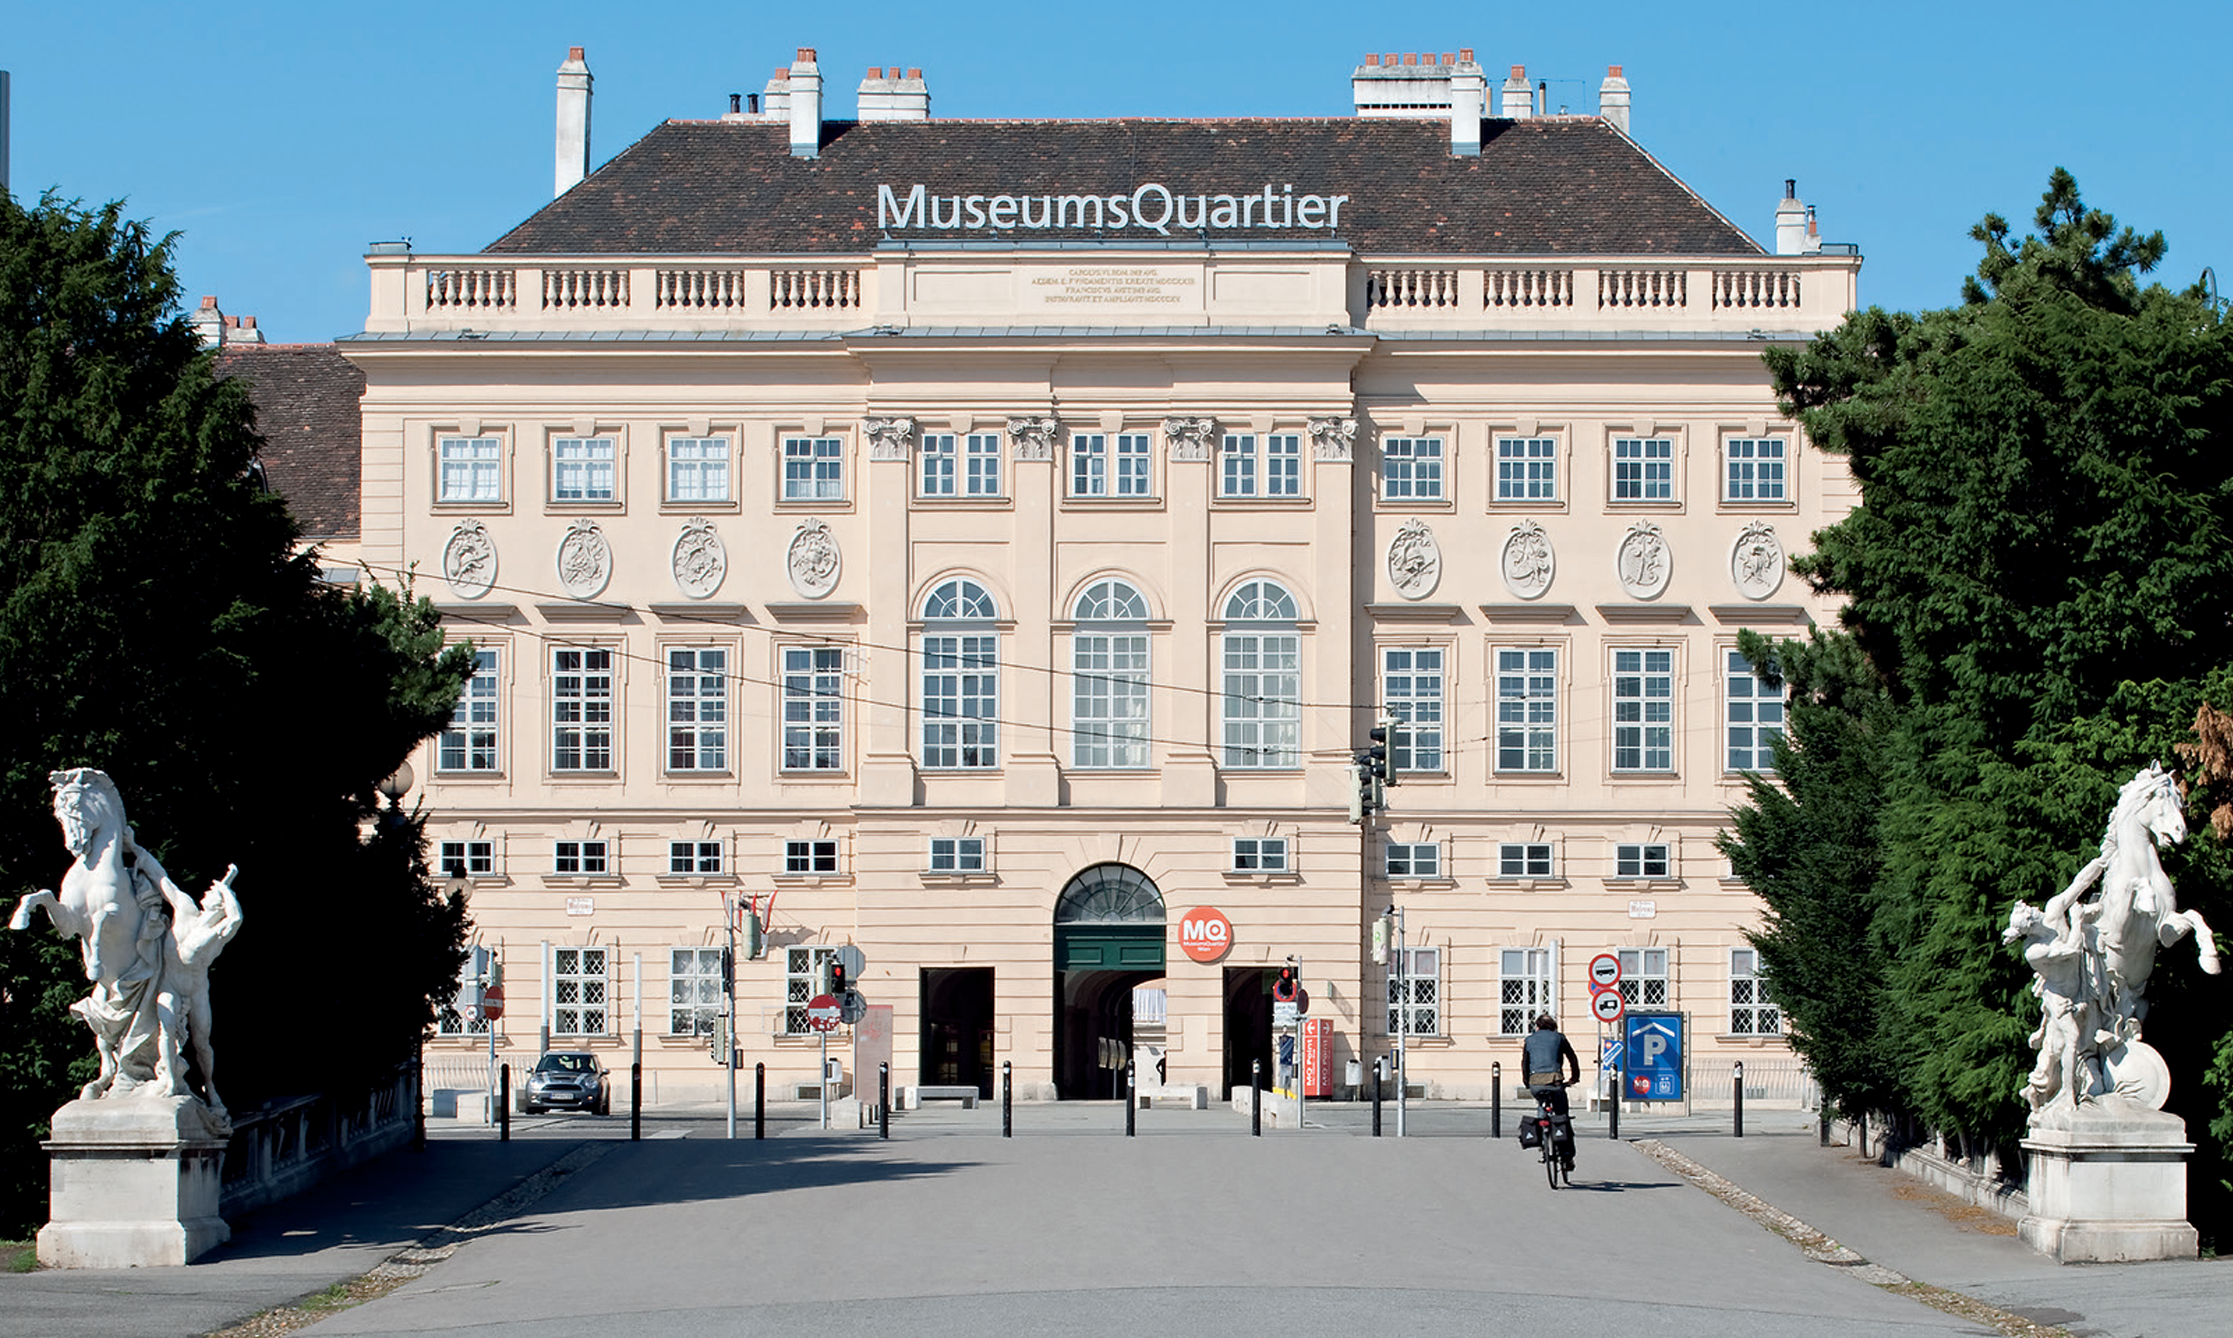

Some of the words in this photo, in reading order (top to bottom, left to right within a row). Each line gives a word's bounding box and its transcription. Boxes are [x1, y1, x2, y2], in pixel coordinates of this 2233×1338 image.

[877, 183, 1349, 235] MuseumsQuartier
[1183, 919, 1227, 941] MQ
[1643, 1034, 1667, 1065] P
[1306, 1067, 1313, 1086] MQ
[1322, 1068, 1329, 1086] MQ
[1634, 1079, 1649, 1088] MQ
